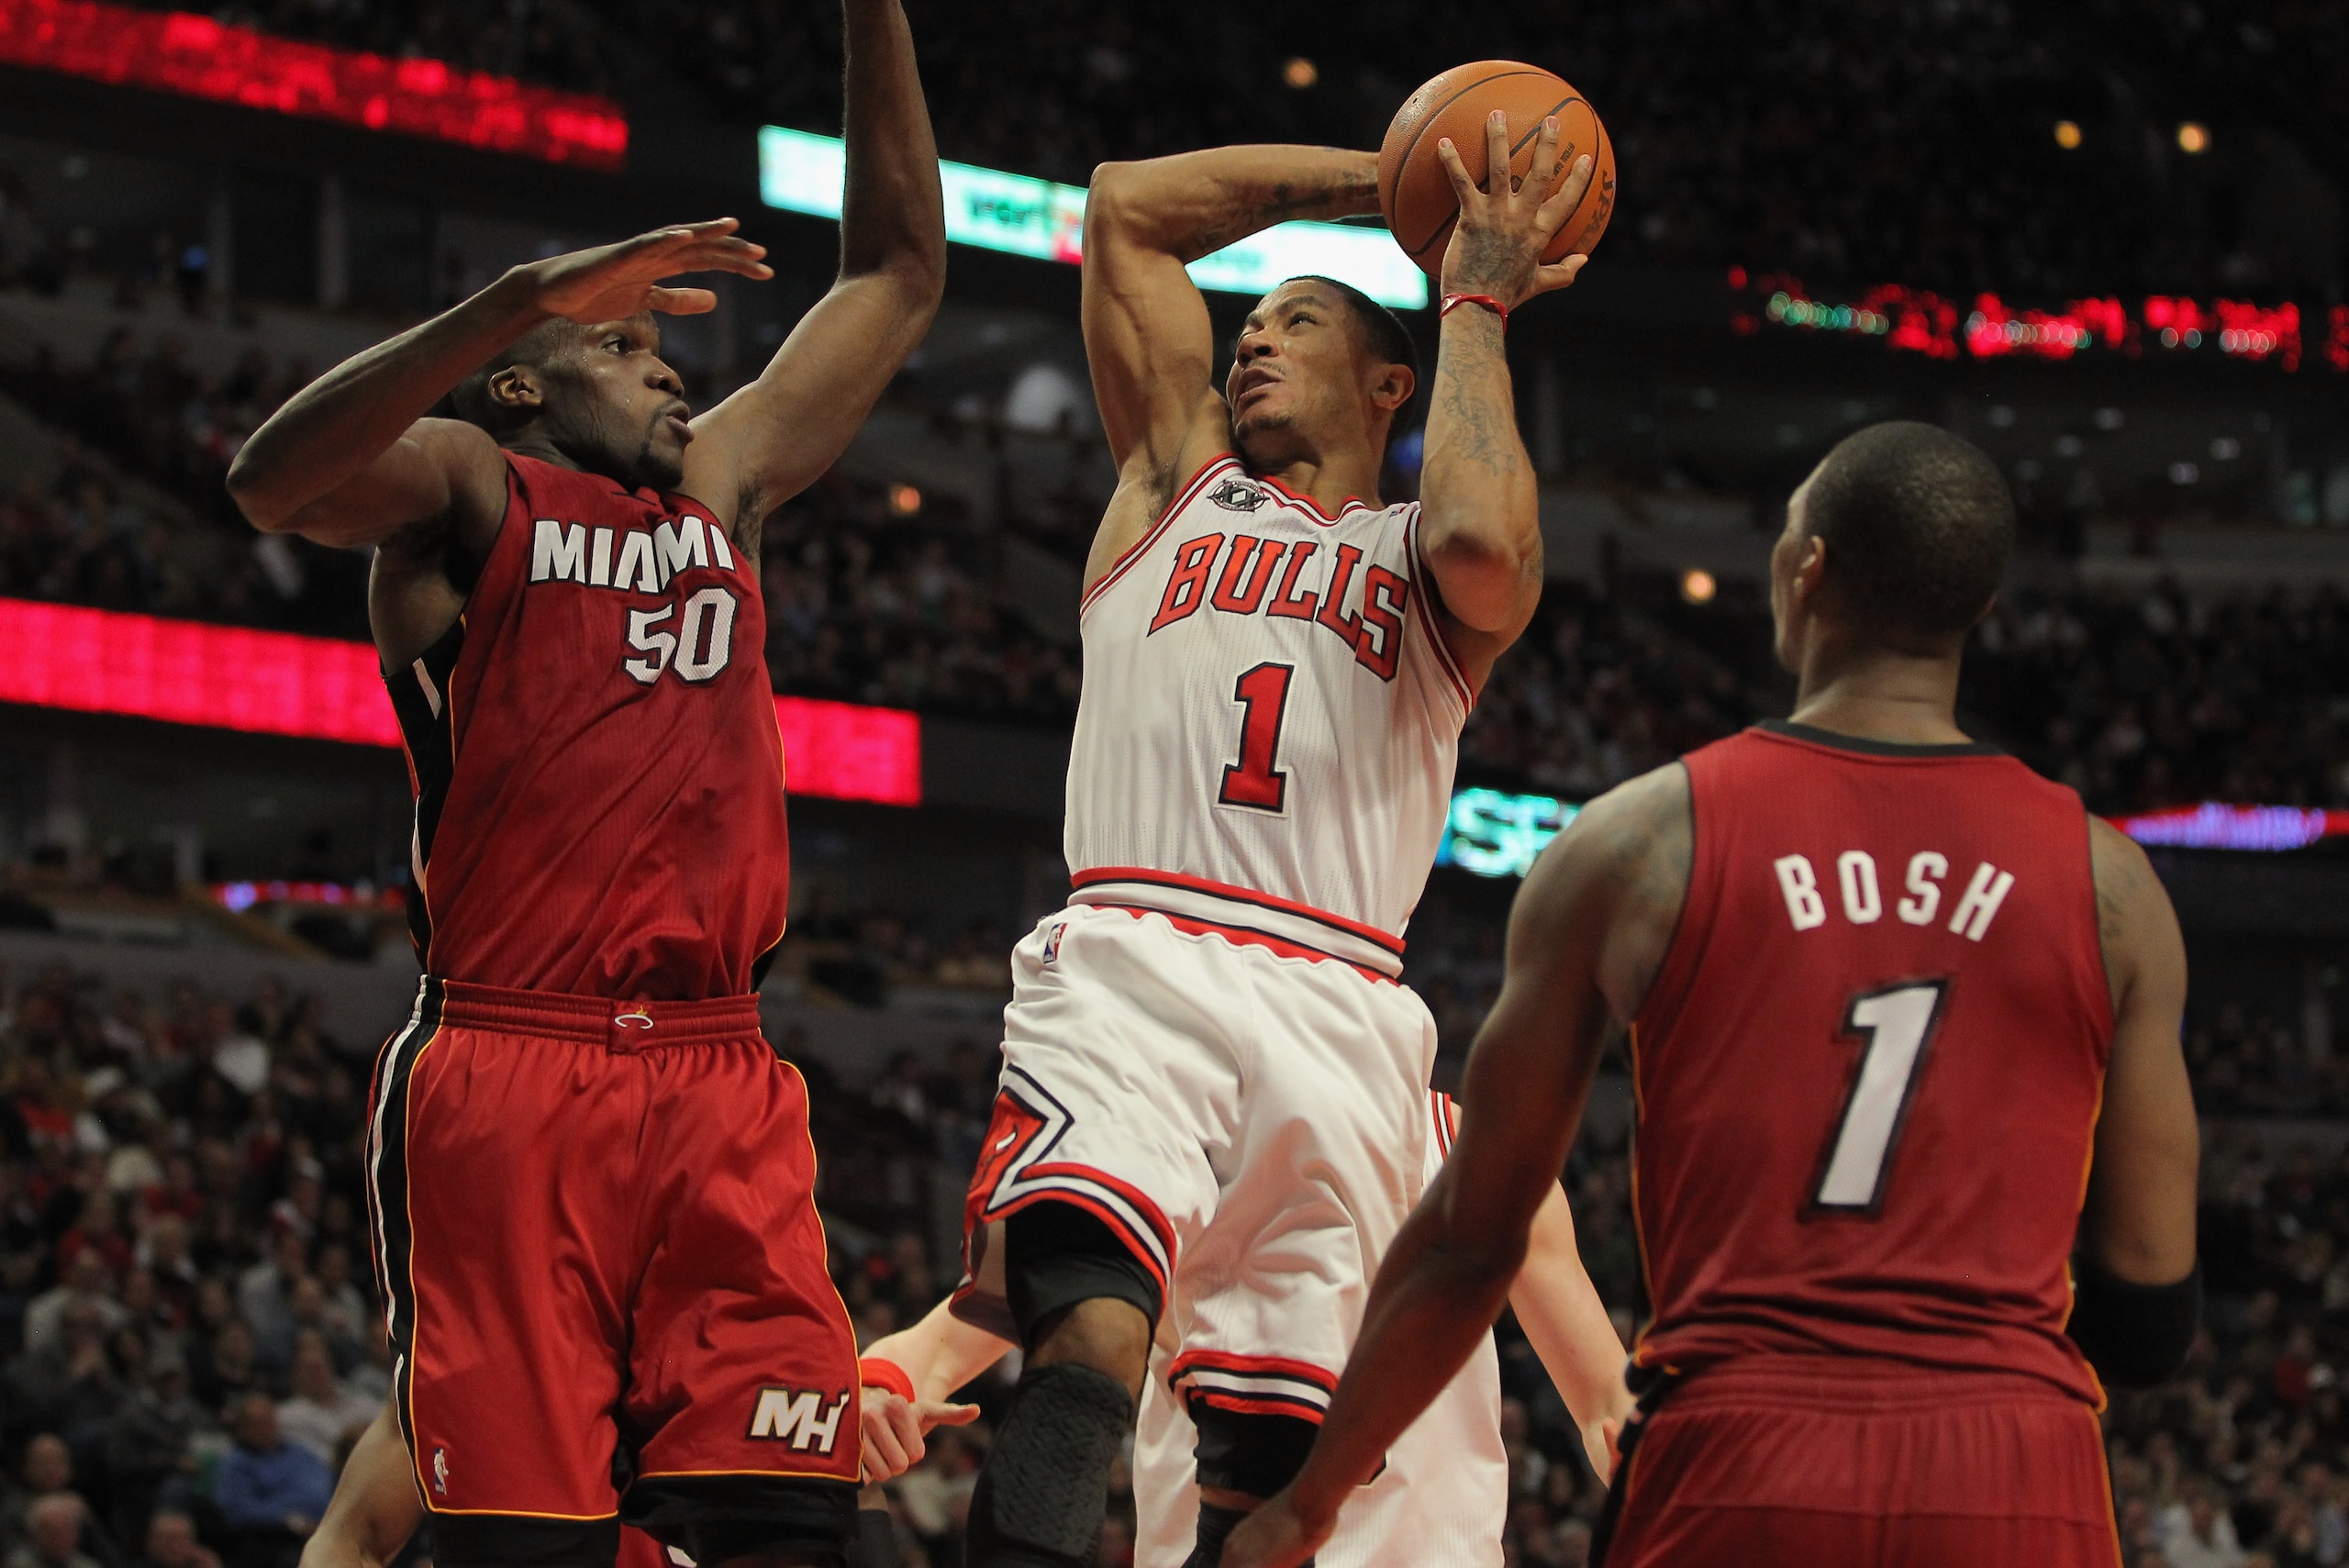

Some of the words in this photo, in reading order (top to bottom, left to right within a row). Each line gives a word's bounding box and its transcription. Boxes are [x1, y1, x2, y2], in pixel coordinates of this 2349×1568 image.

[528, 515, 736, 595] MIAMI
[1147, 531, 1410, 683] BULLS
[622, 584, 739, 684] 50
[1218, 661, 1296, 813] 1
[1774, 850, 2015, 942] BOSH
[1808, 978, 1948, 1213] 1
